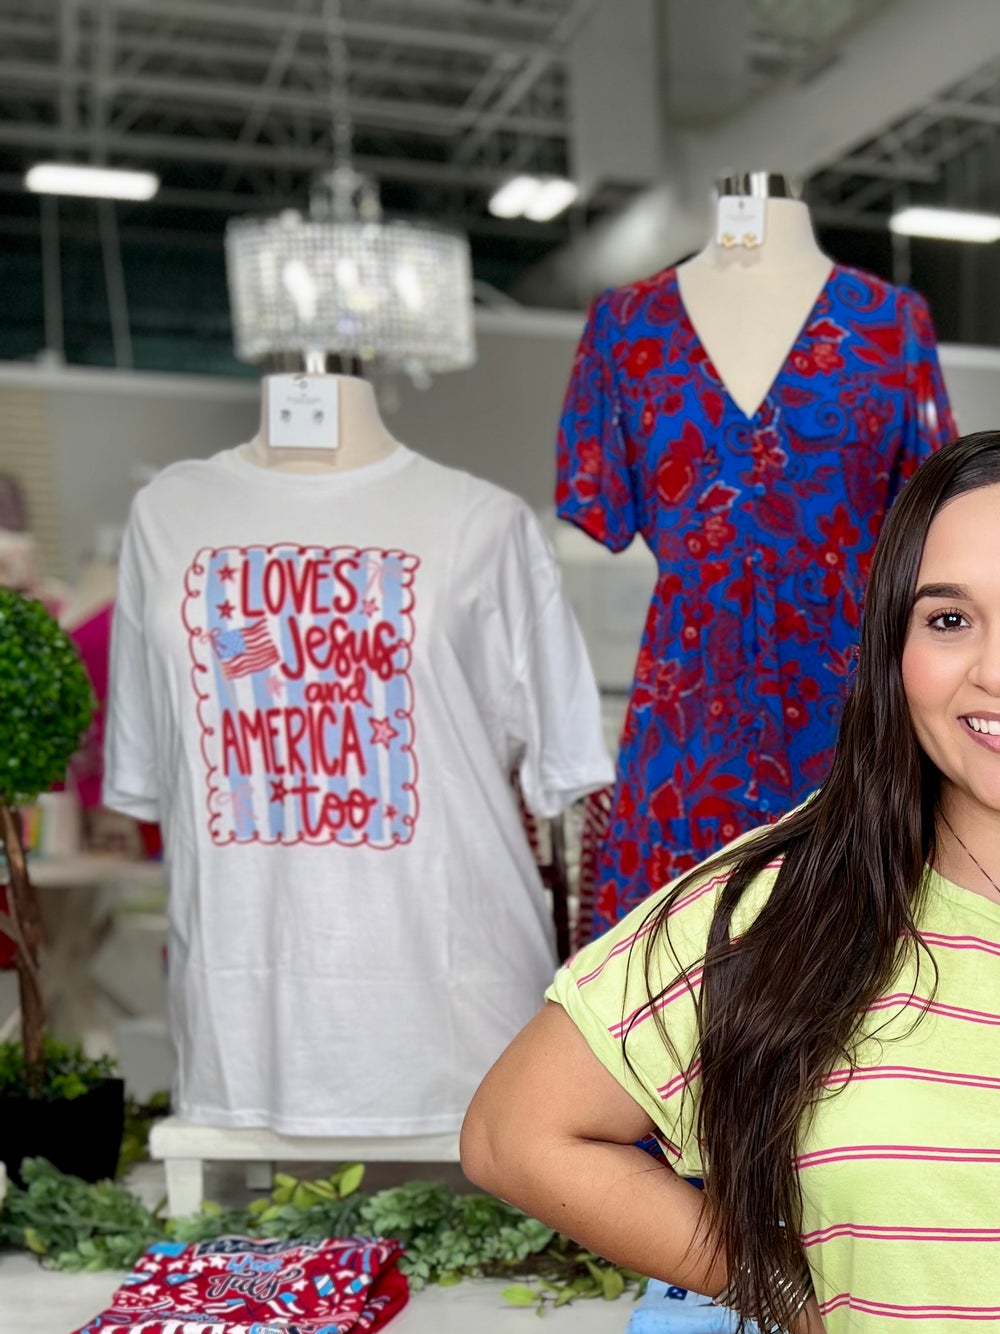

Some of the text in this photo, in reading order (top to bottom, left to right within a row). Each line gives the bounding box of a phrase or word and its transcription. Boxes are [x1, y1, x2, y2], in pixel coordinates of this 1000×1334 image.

[241, 558, 359, 618] LOVES
[281, 616, 400, 681] Jesus
[304, 667, 372, 708] and
[221, 705, 366, 776] AMERICA
[289, 776, 377, 838] too
